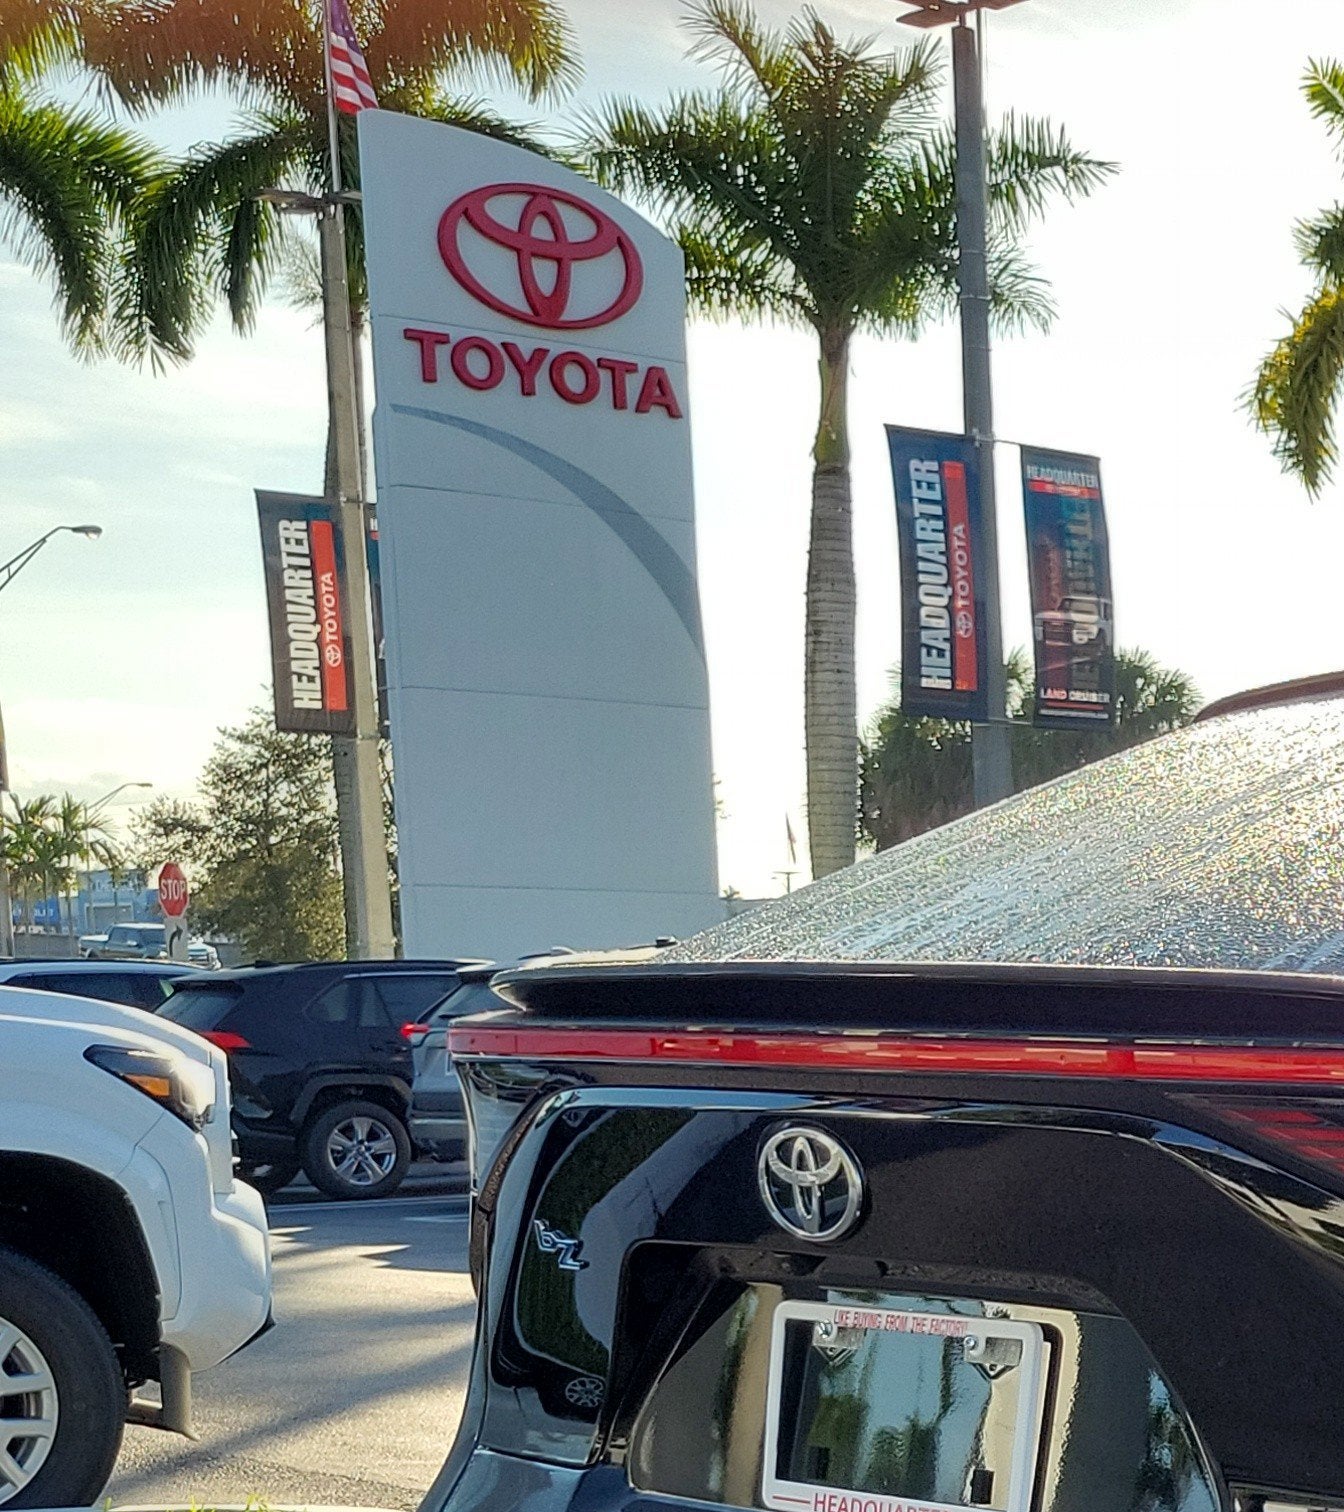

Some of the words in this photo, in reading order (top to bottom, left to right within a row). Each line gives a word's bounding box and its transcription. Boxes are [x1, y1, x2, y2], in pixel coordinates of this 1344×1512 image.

[403, 328, 683, 419] TOYOTA
[321, 571, 341, 643] TOYOTA
[909, 458, 952, 690] HEADQUARTER
[952, 522, 972, 607] TOYOTA
[278, 519, 322, 709] HEADQUARTER
[160, 878, 186, 900] STOP
